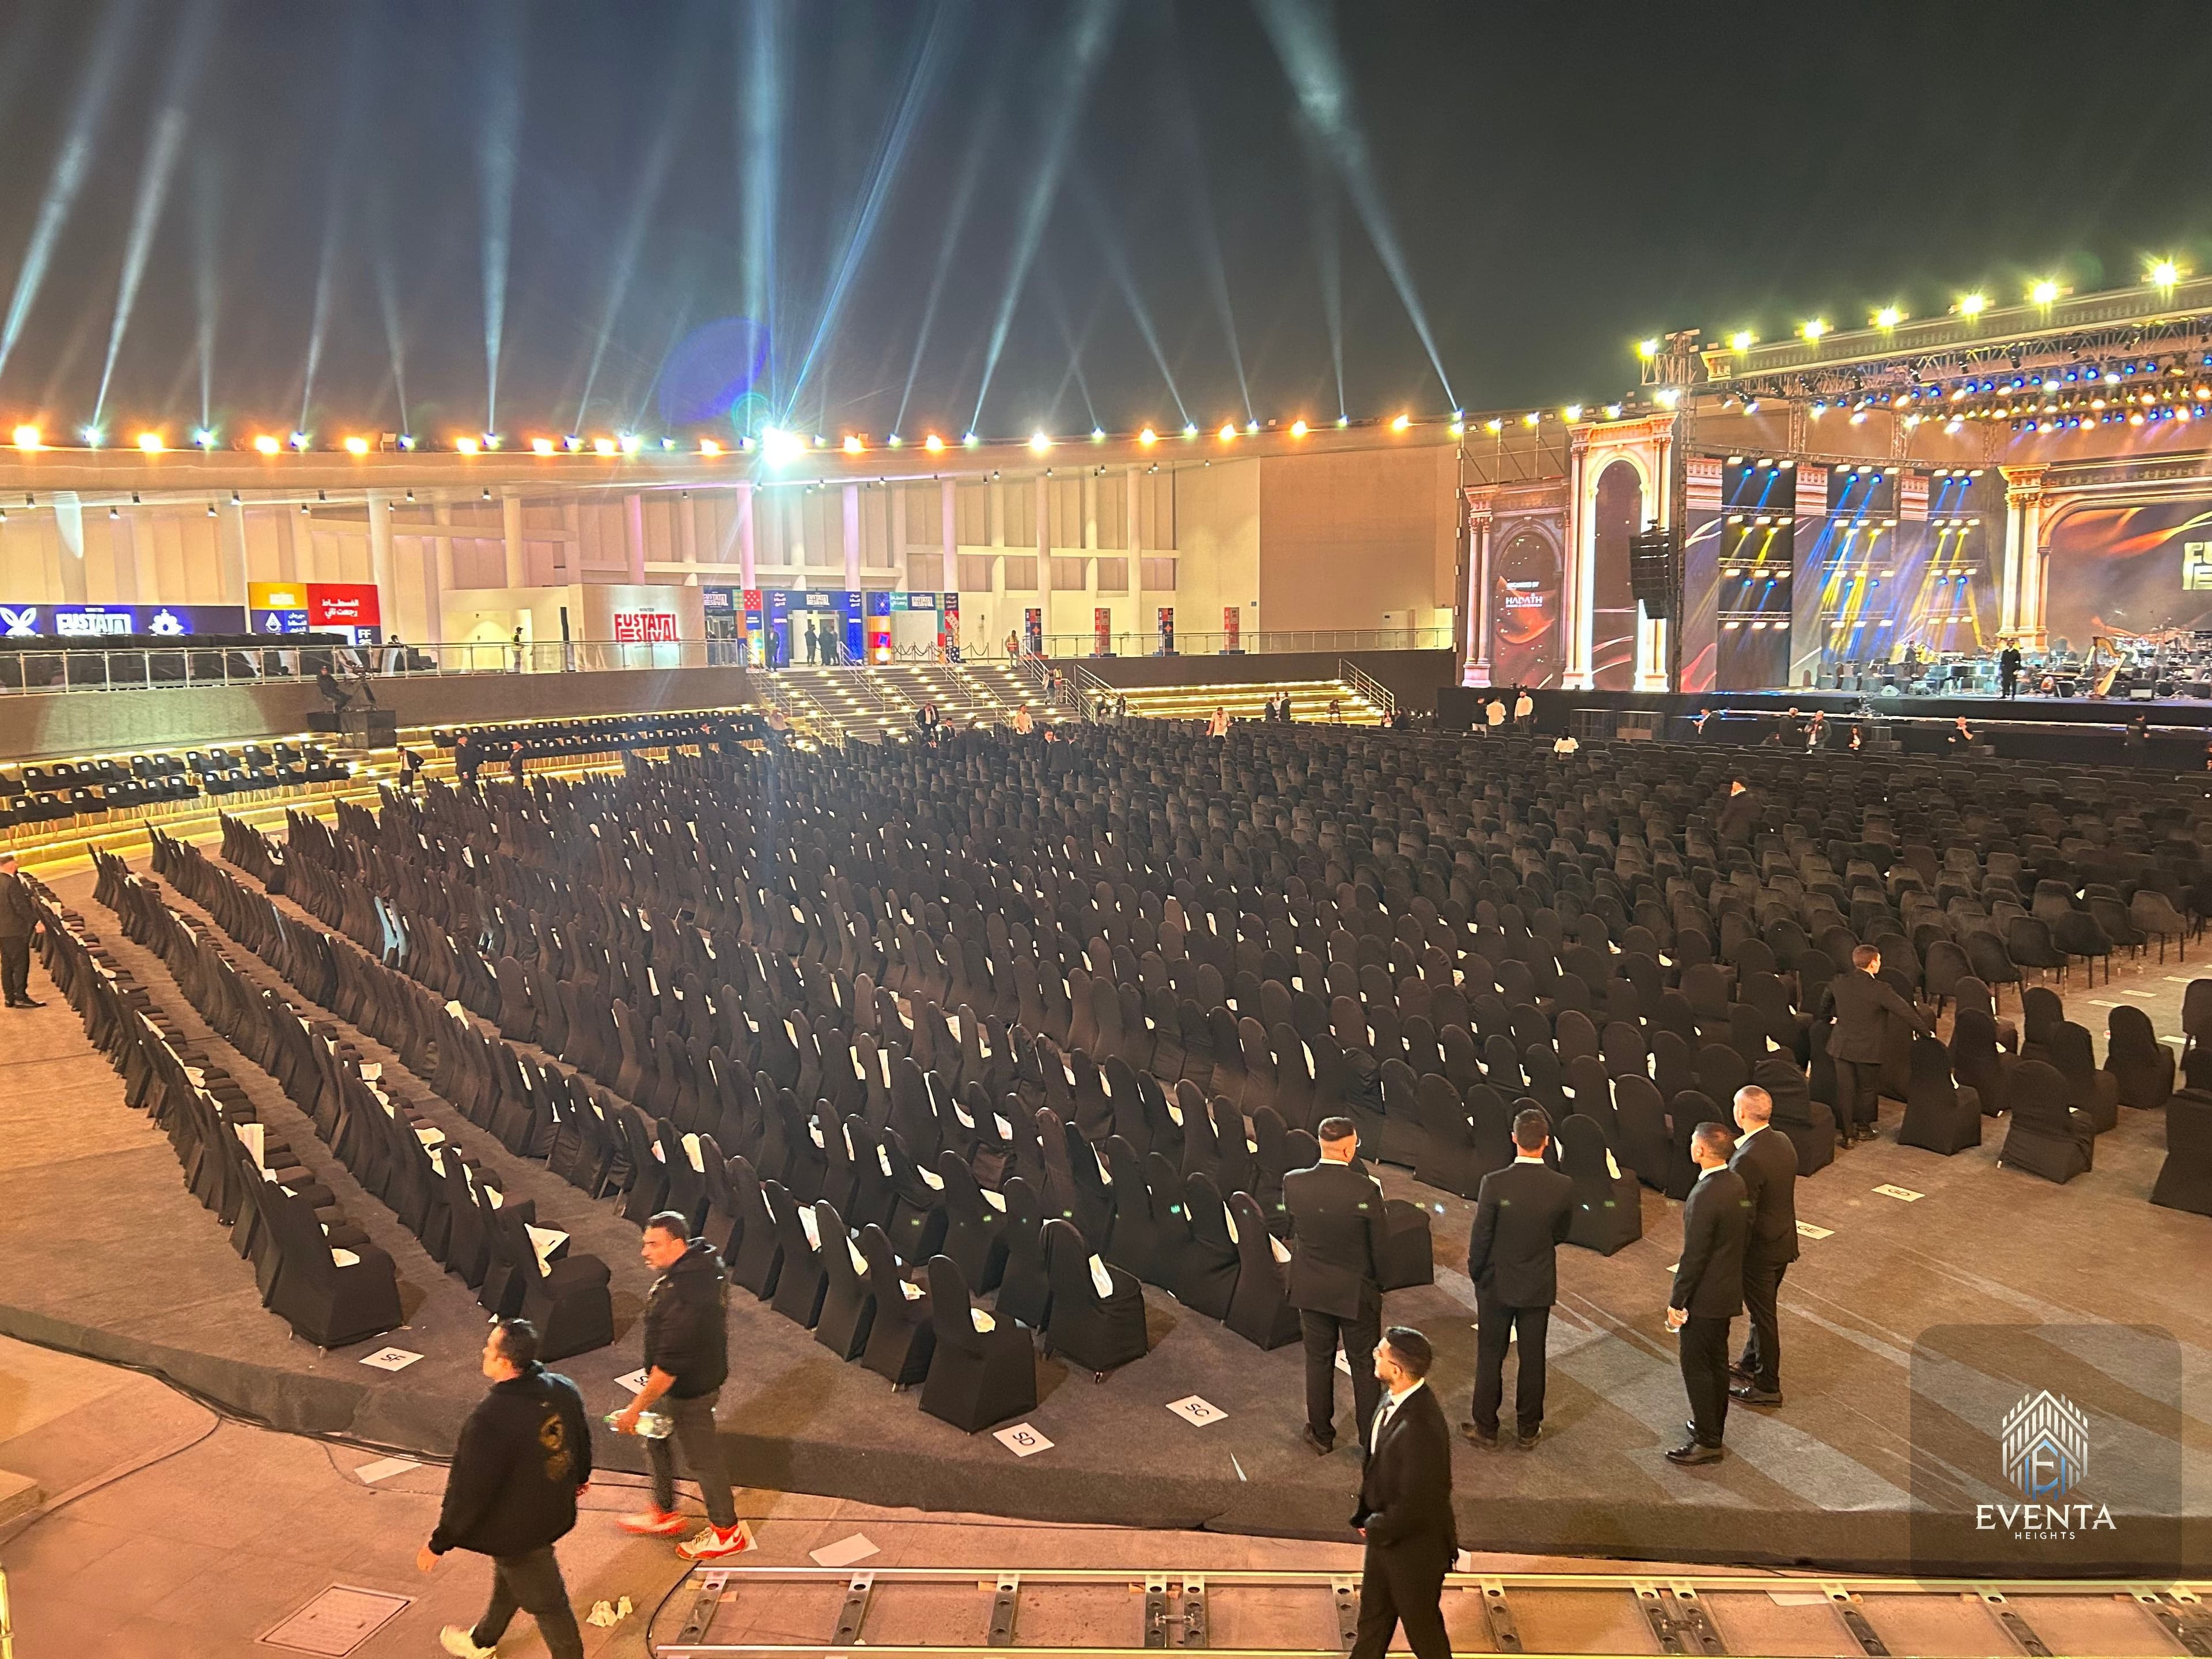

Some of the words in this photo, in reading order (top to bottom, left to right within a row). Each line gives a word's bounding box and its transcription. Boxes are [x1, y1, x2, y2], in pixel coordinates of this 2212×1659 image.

[1505, 596, 1543, 604] HADATH
[358, 629, 372, 638] FF
[1797, 1225, 1820, 1234] GE
[380, 1354, 407, 1362] SF
[1185, 1403, 1210, 1417] SC
[1012, 1431, 1036, 1446] SD
